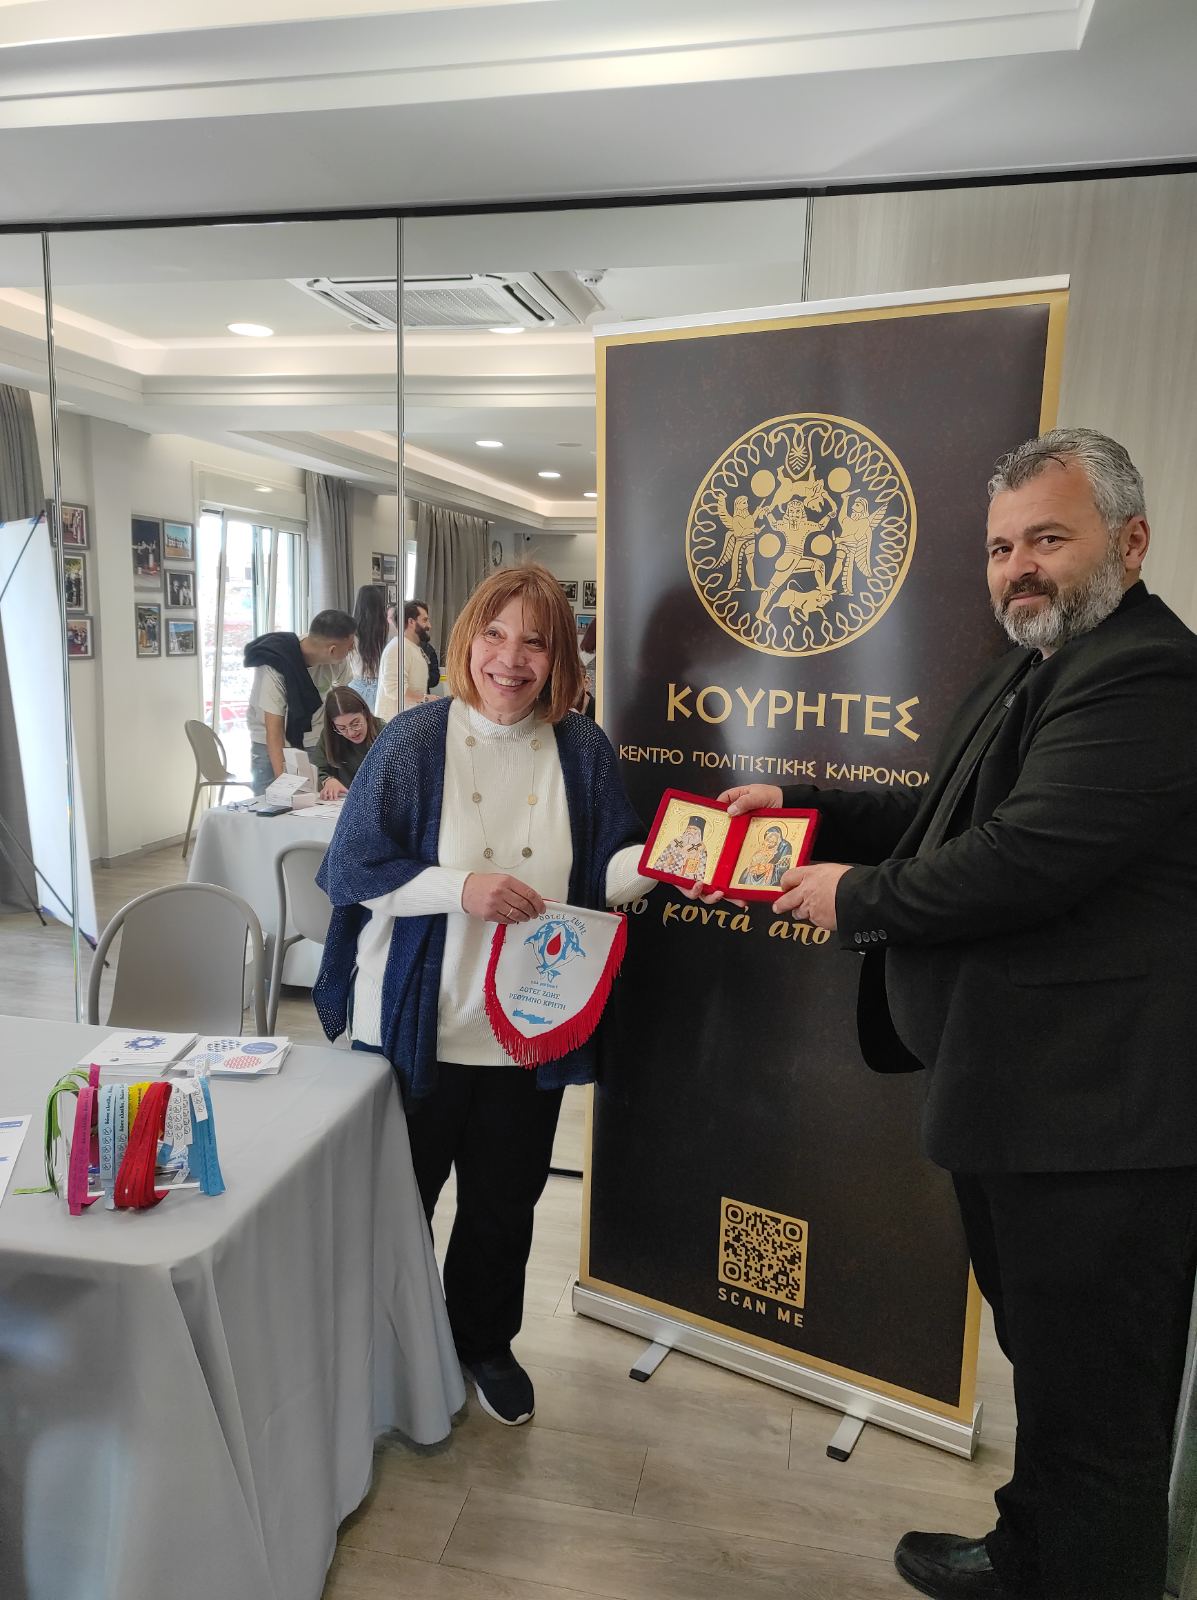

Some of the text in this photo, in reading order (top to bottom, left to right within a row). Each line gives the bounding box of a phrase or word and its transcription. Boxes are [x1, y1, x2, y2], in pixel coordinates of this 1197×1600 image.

[667, 683, 920, 742] ΚΟΥΡΗΤΕΣ
[619, 744, 930, 787] ΚΕΝΤΡΟ ΠΟΛΙΤΙΣΤΙΚΗΣ ΚΛΗΡΟΝΟ
[718, 1288, 804, 1328] SCAN ME
